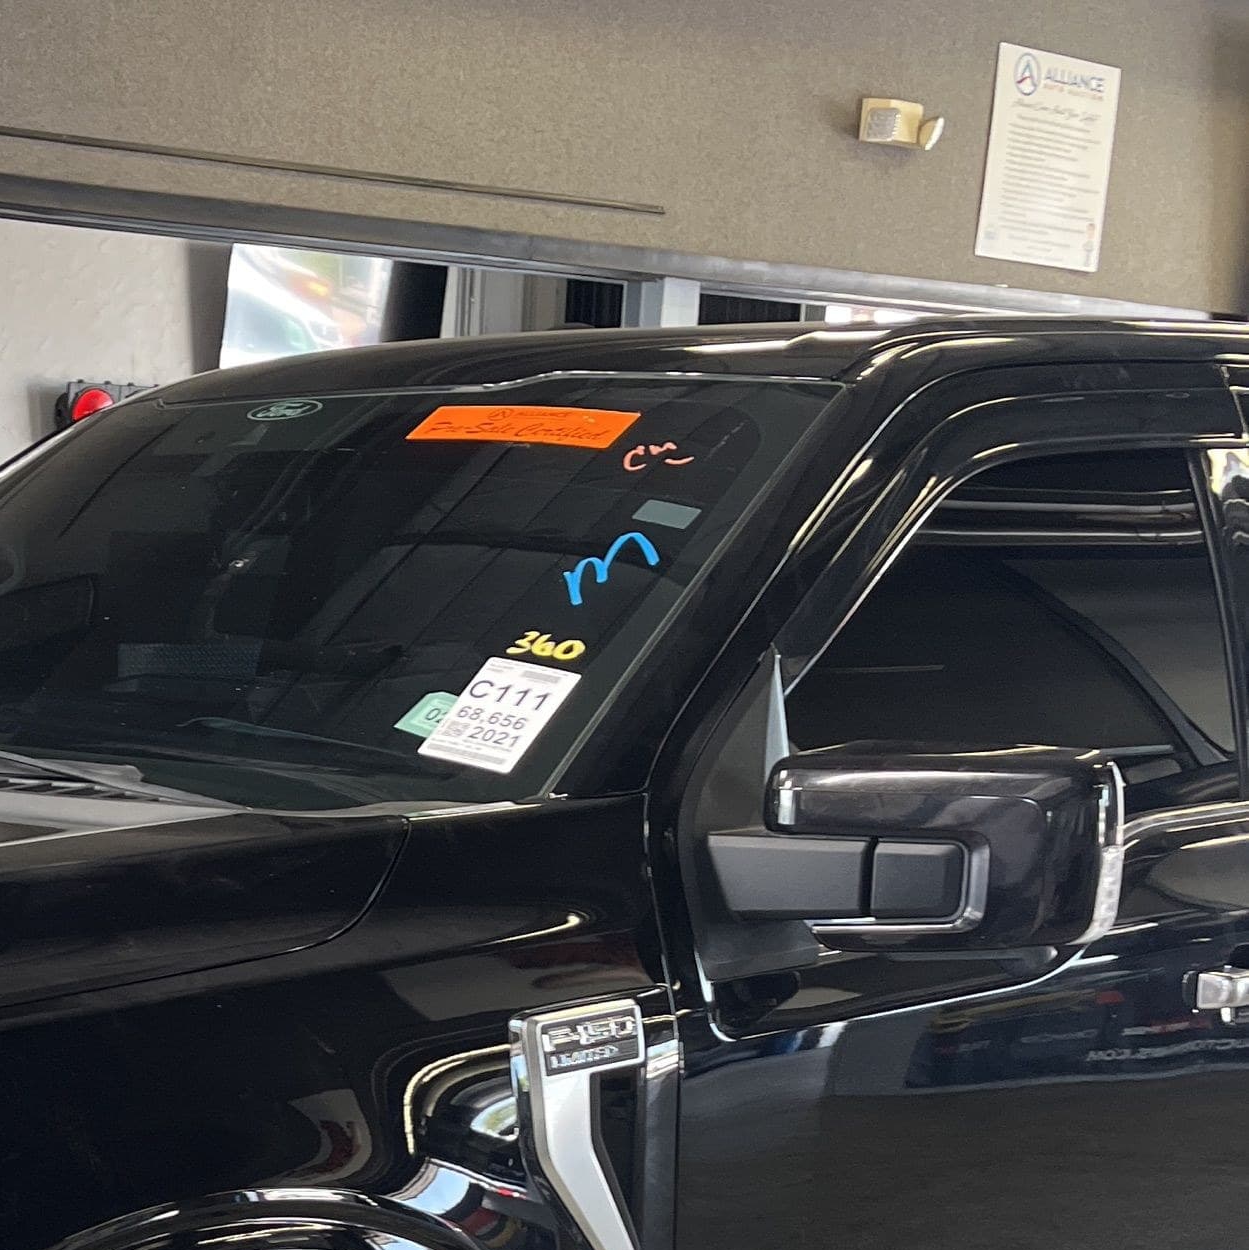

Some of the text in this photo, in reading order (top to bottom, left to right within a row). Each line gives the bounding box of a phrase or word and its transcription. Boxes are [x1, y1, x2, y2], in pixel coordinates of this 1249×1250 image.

[1044, 66, 1105, 93] ALLIANCE
[505, 630, 586, 661] 360
[469, 680, 551, 711] C111
[456, 705, 528, 731] 68,656
[468, 726, 520, 748] 2021
